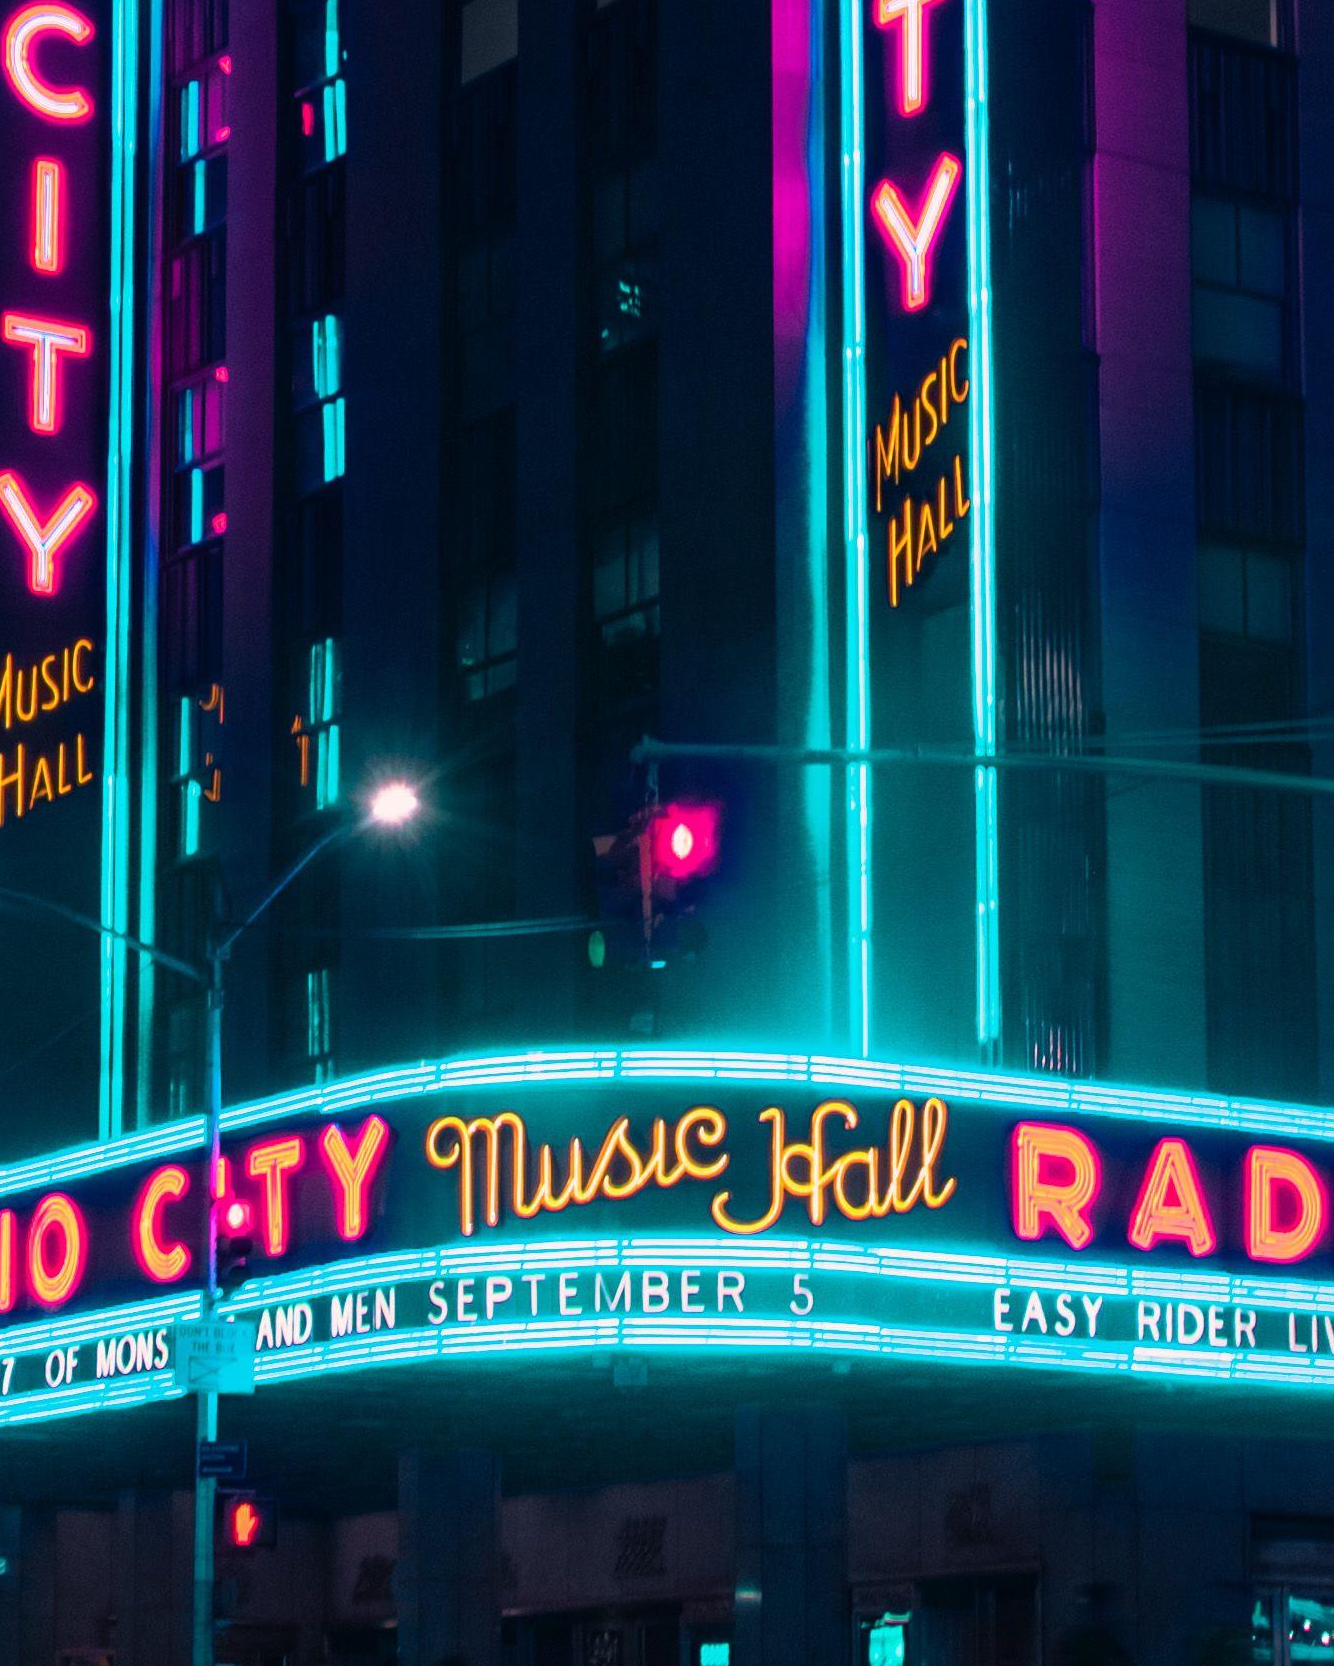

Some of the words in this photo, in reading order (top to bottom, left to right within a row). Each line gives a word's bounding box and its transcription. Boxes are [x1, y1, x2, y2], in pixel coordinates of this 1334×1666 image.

[425, 1107, 729, 1236] Music
[711, 1097, 956, 1235] Hall
[45, 1348, 80, 1388] OF
[97, 1329, 170, 1380] MONS
[255, 1301, 313, 1352] AND
[330, 1287, 397, 1338] MEN
[427, 1269, 745, 1326] SEPTEMBER
[788, 1272, 815, 1316] 5
[992, 1286, 1105, 1340] EASY
[1136, 1300, 1258, 1349] RIDER
